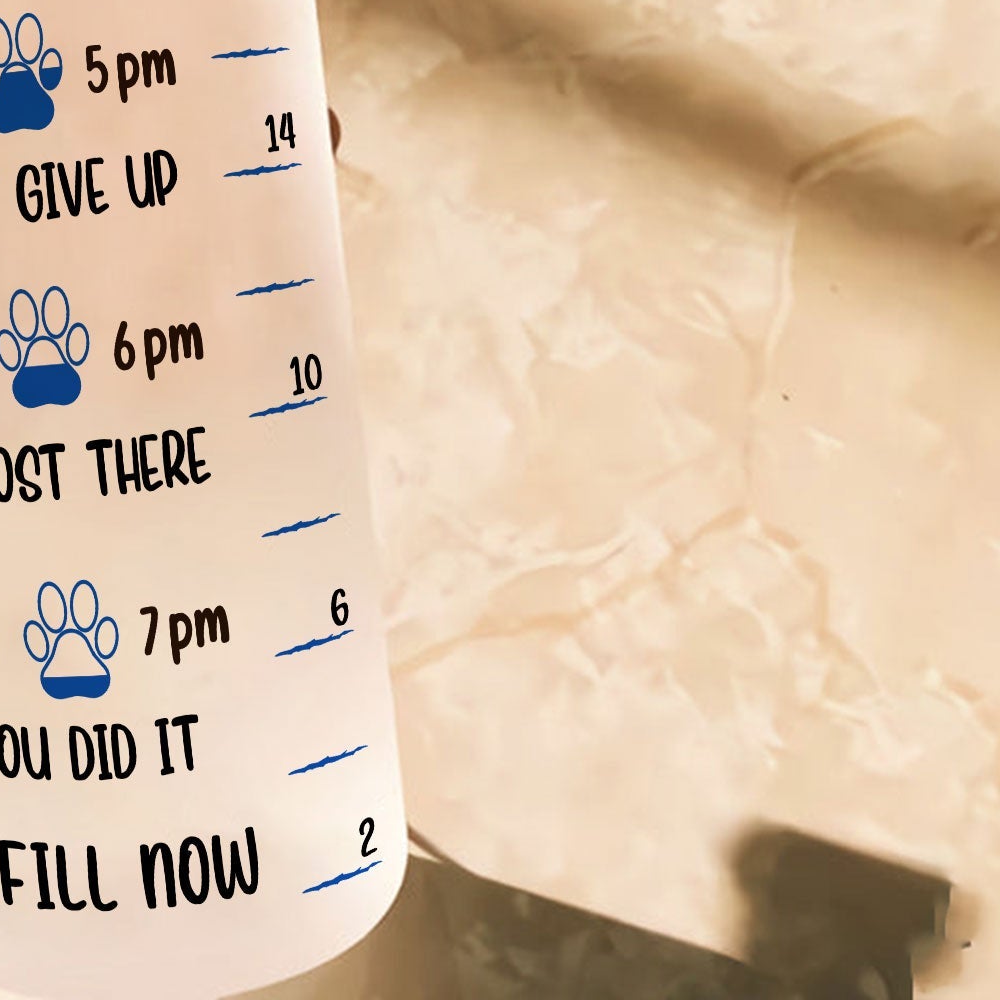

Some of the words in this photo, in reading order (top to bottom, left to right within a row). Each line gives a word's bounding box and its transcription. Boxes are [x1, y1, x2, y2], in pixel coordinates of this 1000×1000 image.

[264, 111, 297, 153] 14
[15, 156, 110, 223] GIVE
[125, 149, 178, 209] UP
[289, 353, 323, 396] 10
[85, 426, 212, 497] THERE
[330, 588, 349, 627] 6
[68, 723, 137, 781] DID
[154, 713, 199, 776] IT
[358, 816, 378, 858] 2
